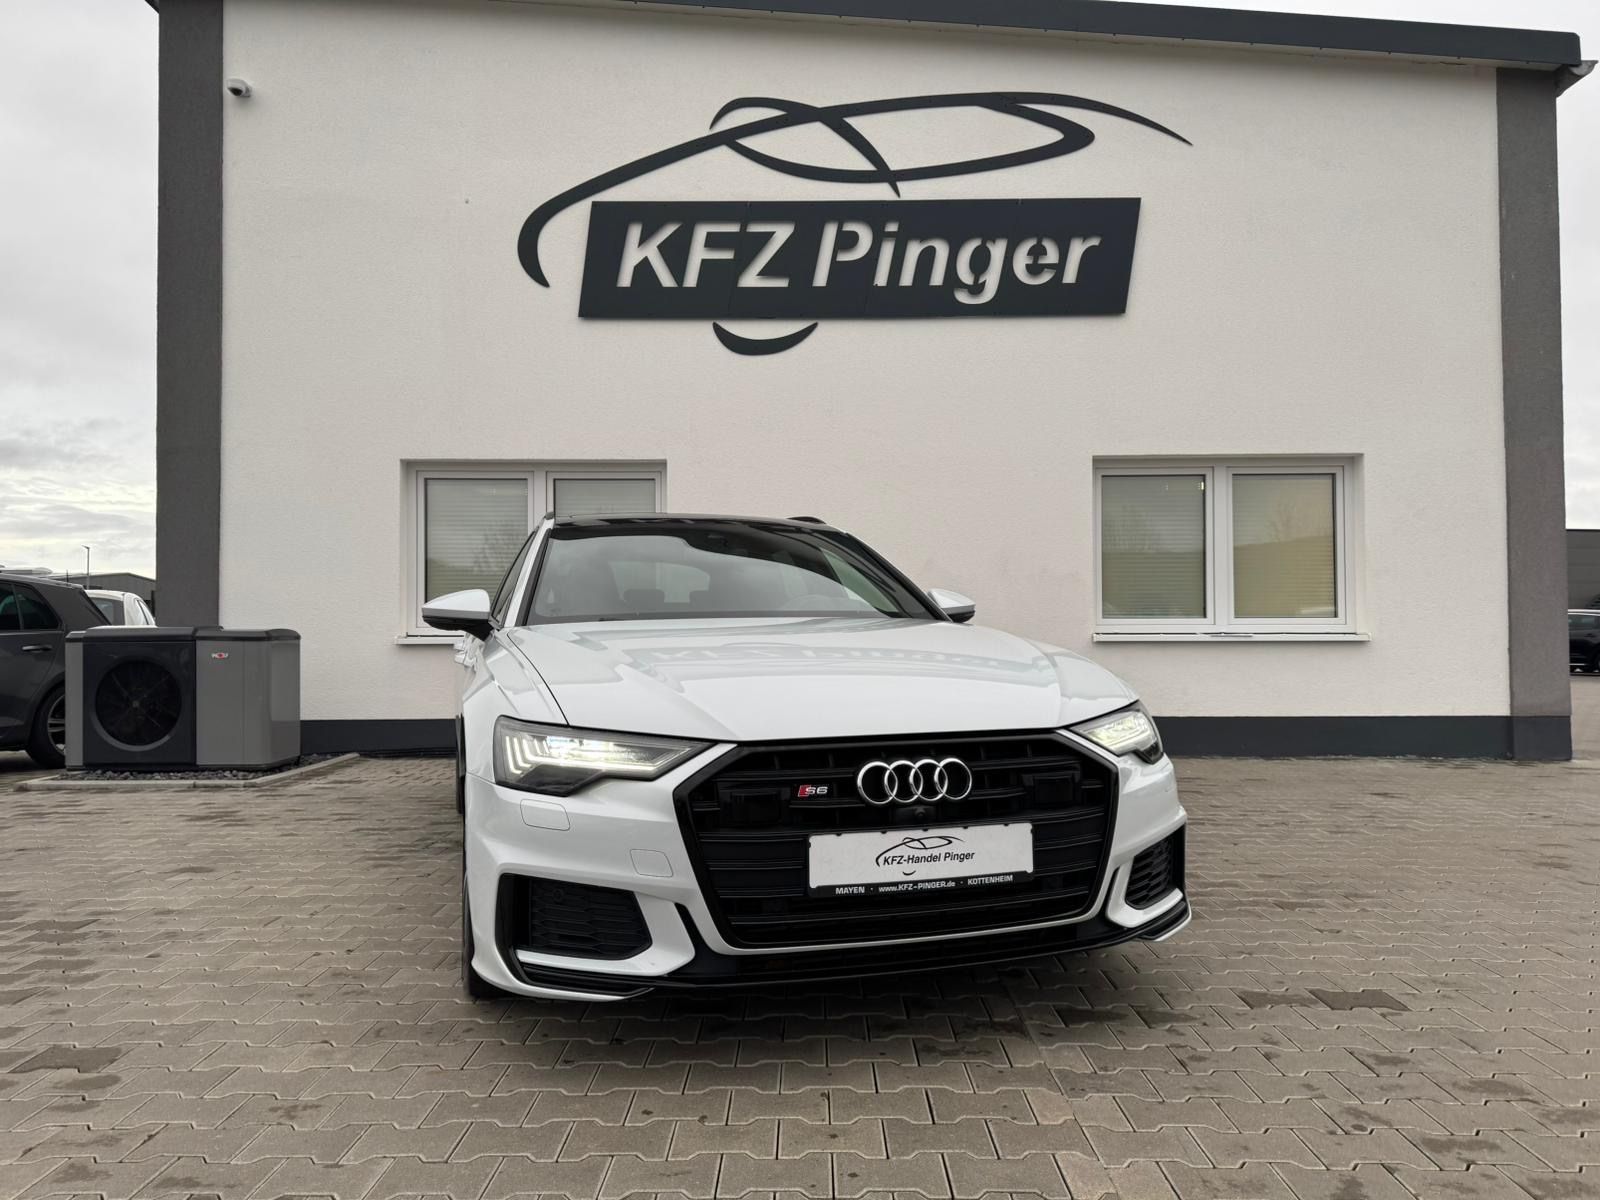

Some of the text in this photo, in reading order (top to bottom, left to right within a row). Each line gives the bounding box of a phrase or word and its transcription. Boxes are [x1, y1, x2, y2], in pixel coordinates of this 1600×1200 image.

[616, 221, 1102, 304] KFZ Pinger
[804, 786, 828, 795] S6
[883, 851, 975, 866] KFZ-Handel Pinger
[835, 875, 1013, 895] MAYEN www.KFZ-PINGER.de KOTTENHEIM
